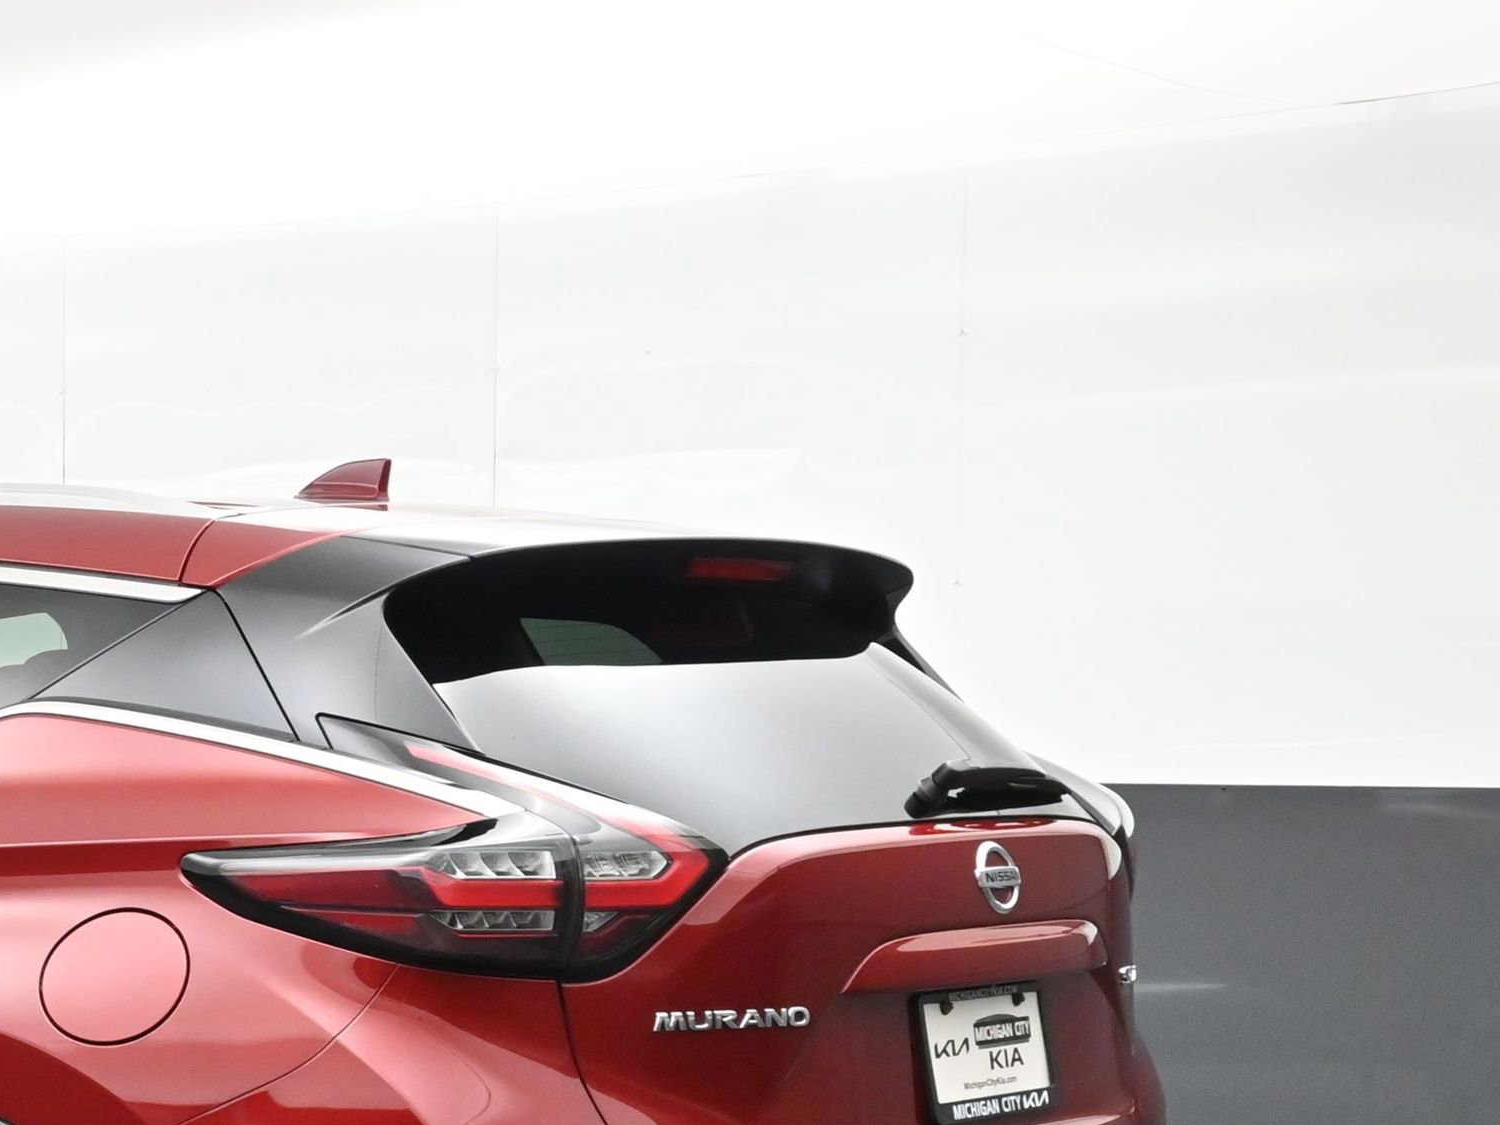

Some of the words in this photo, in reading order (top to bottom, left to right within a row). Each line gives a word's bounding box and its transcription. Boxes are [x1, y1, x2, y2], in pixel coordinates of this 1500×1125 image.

[652, 1006, 811, 1032] MURANO
[974, 1023, 1013, 1042] MICHIGAN
[1014, 1020, 1030, 1036] CITY
[989, 1047, 1024, 1070] KIA
[952, 1098, 1001, 1120] MICHIGAN
[1001, 1095, 1021, 1113] CITY
